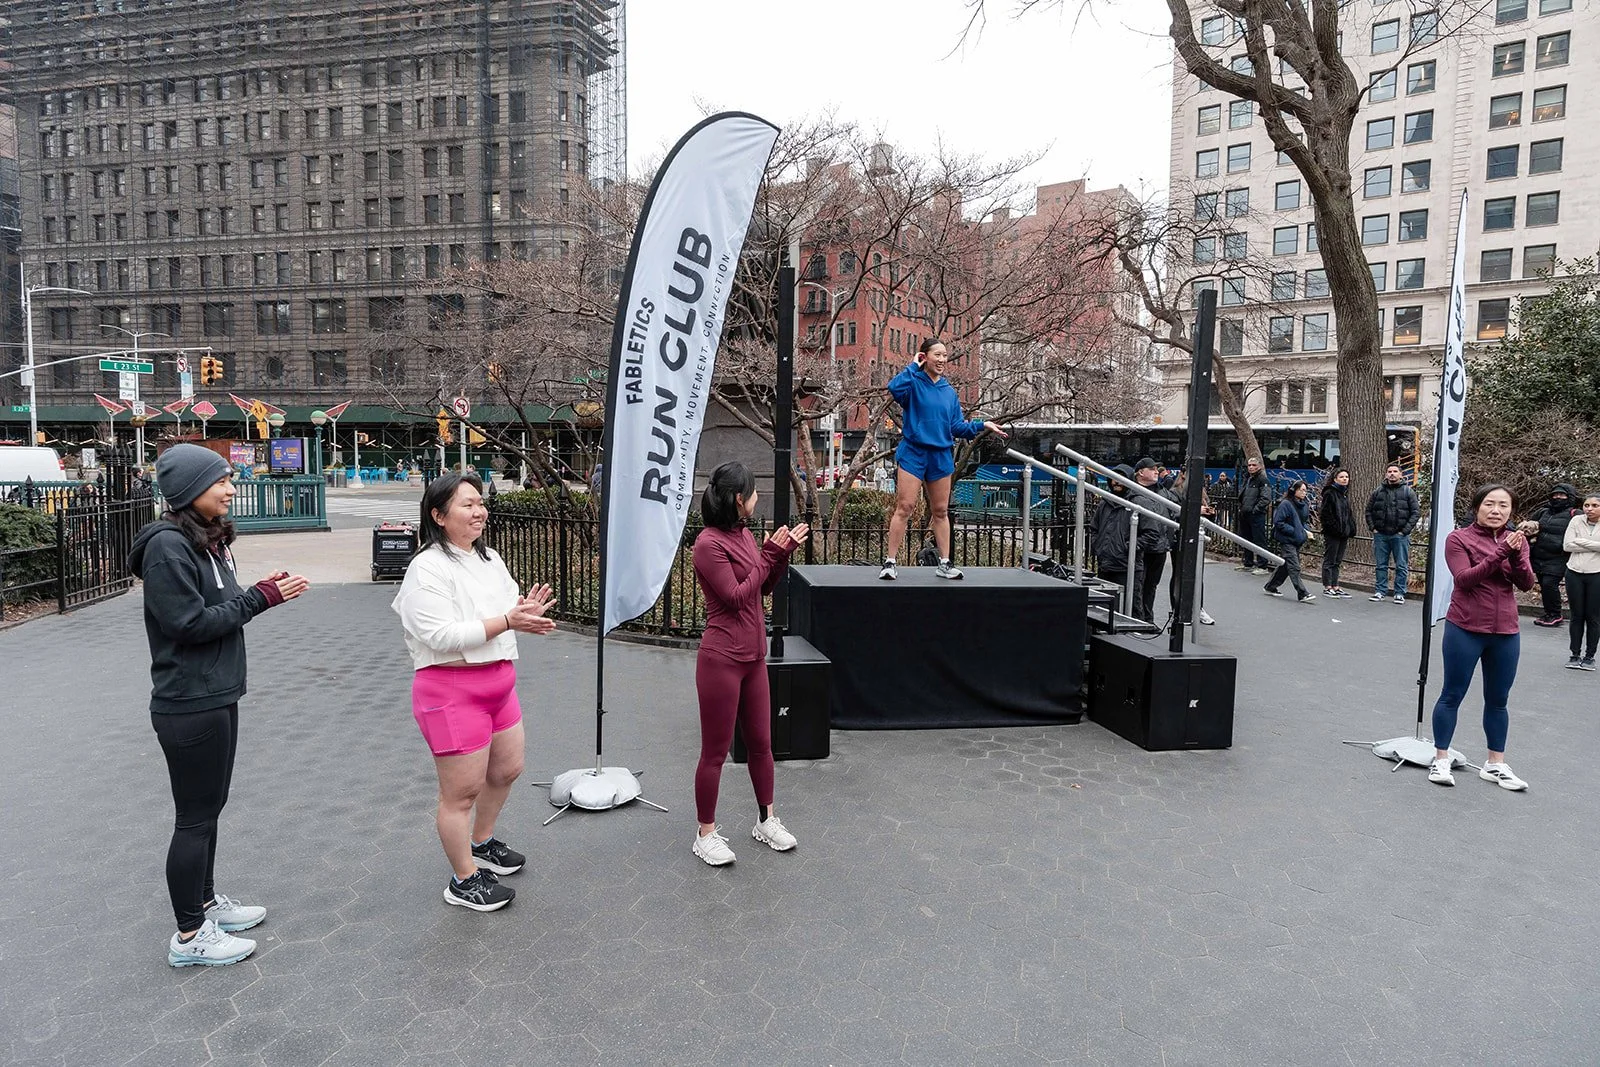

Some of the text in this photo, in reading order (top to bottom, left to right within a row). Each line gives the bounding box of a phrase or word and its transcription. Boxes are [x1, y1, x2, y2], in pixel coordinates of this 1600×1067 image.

[625, 297, 655, 405] FABLETICS
[640, 227, 712, 505] RUN CLUB
[685, 345, 708, 420] MOVEMENT.
